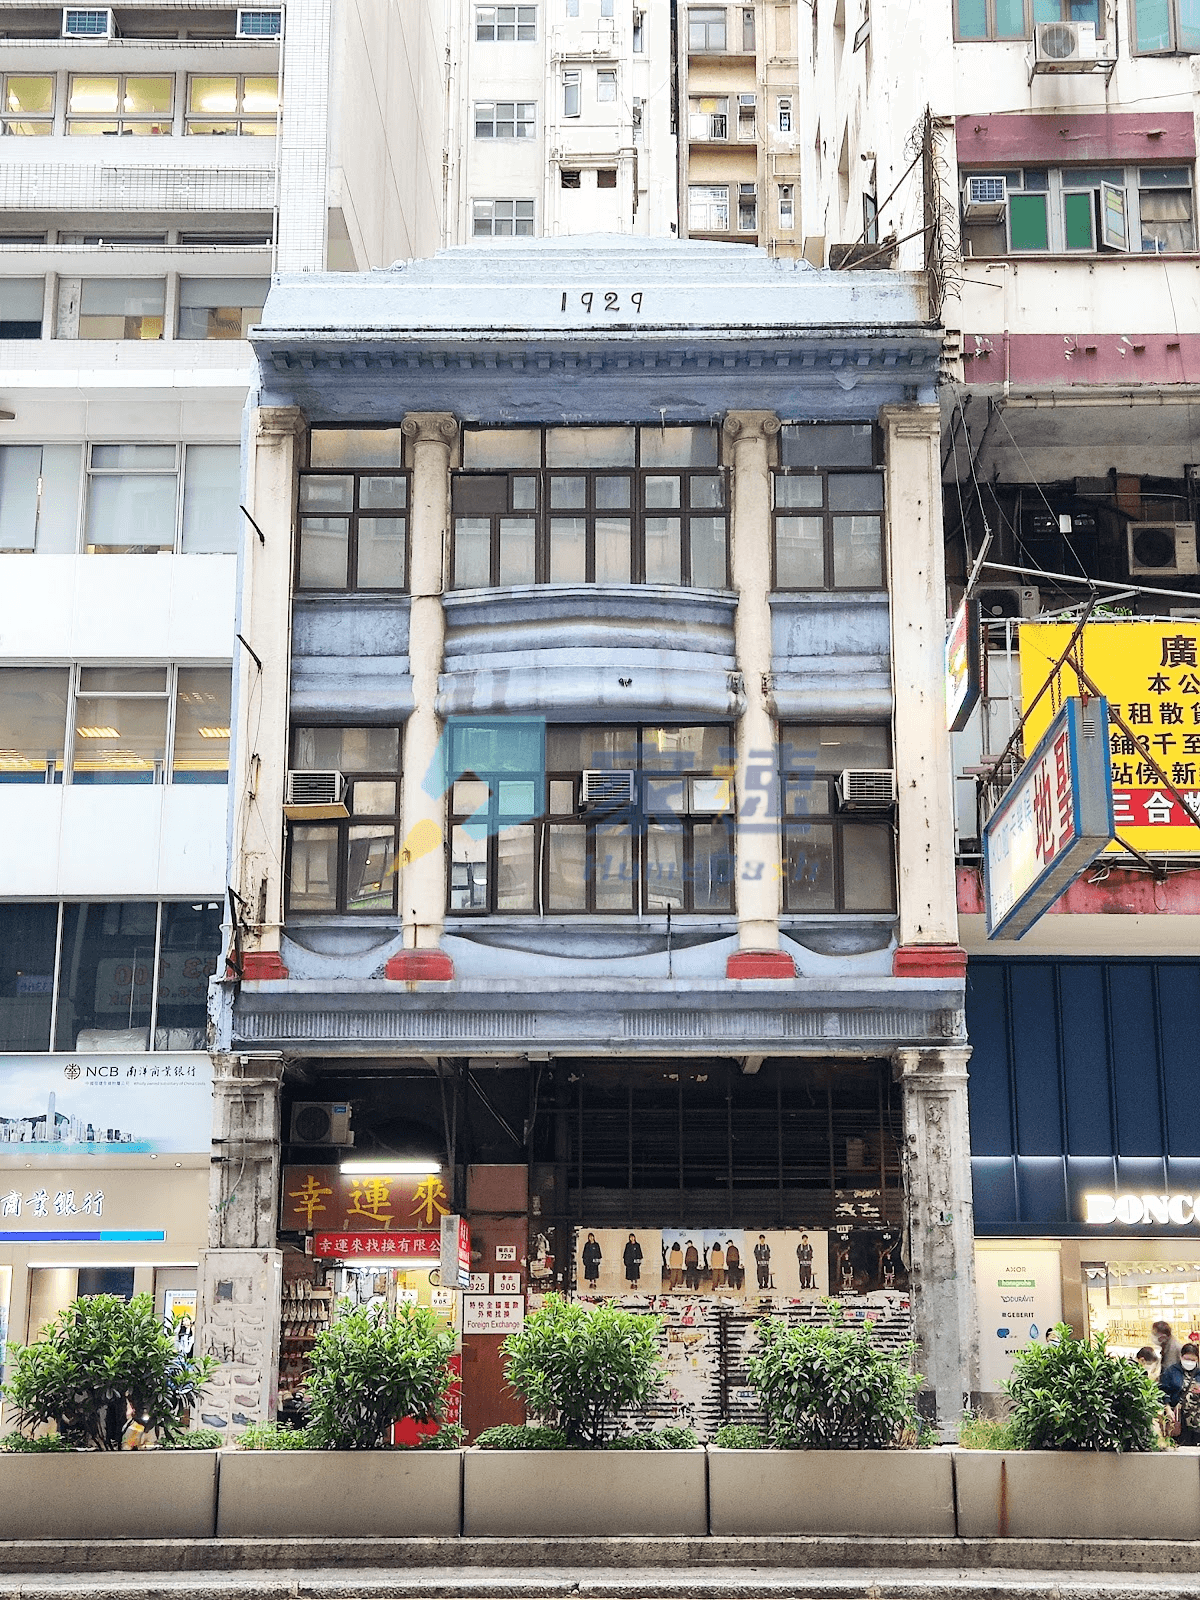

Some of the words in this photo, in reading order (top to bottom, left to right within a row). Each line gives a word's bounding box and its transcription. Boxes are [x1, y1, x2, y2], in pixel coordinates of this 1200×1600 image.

[560, 291, 643, 314] 1929
[86, 1066, 119, 1077] NCB
[126, 1065, 196, 1078] 南洋商業銀行
[0, 1188, 105, 1218] 商業銀行
[288, 1174, 450, 1224] 幸運來
[1084, 1194, 1200, 1225] BONC
[470, 1282, 485, 1291] 925
[500, 1282, 516, 1291] 905
[467, 1320, 490, 1330] Foreign
[490, 1320, 520, 1330] Exchange
